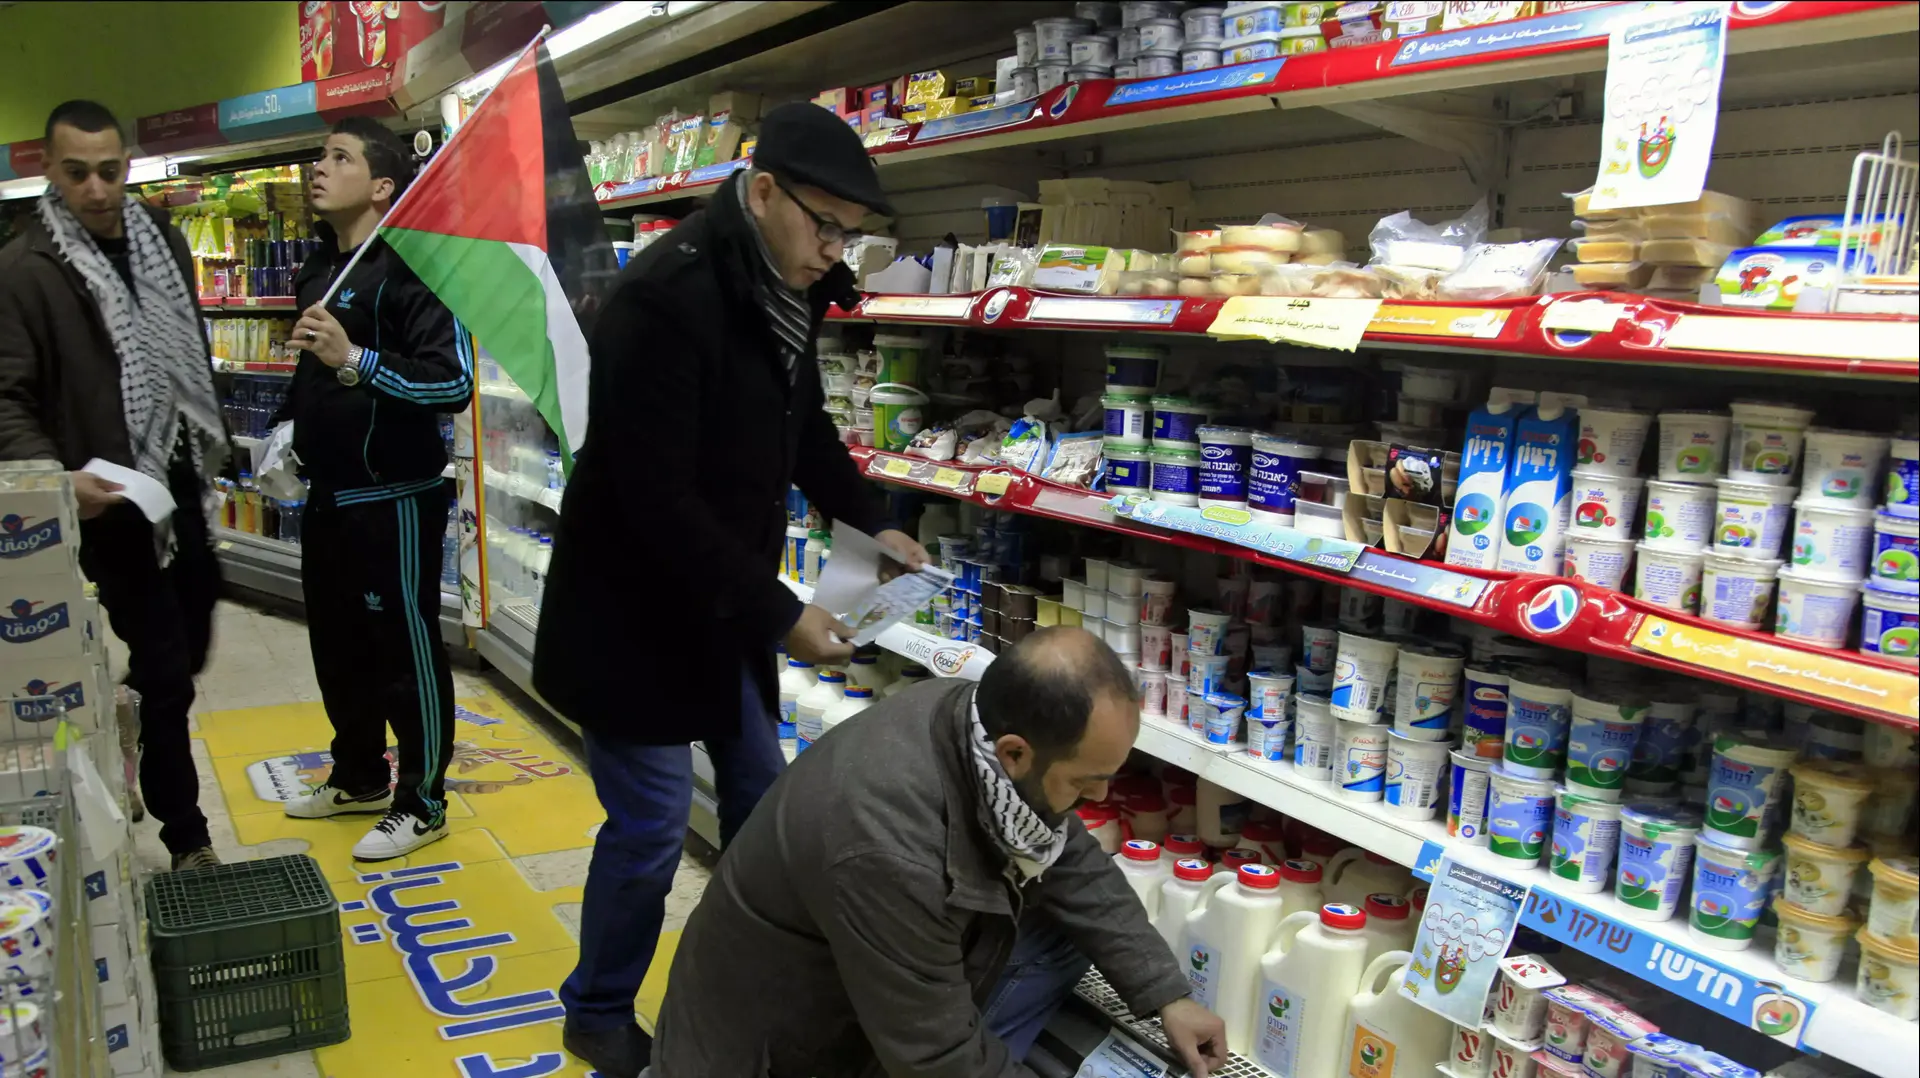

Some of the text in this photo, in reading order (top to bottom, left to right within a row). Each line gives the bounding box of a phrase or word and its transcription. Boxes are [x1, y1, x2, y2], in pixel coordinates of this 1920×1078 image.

[905, 638, 931, 659] white
[938, 652, 956, 668] Yoplait
[1567, 908, 1633, 954] שוקו
[1646, 943, 1743, 1007] חדש!
